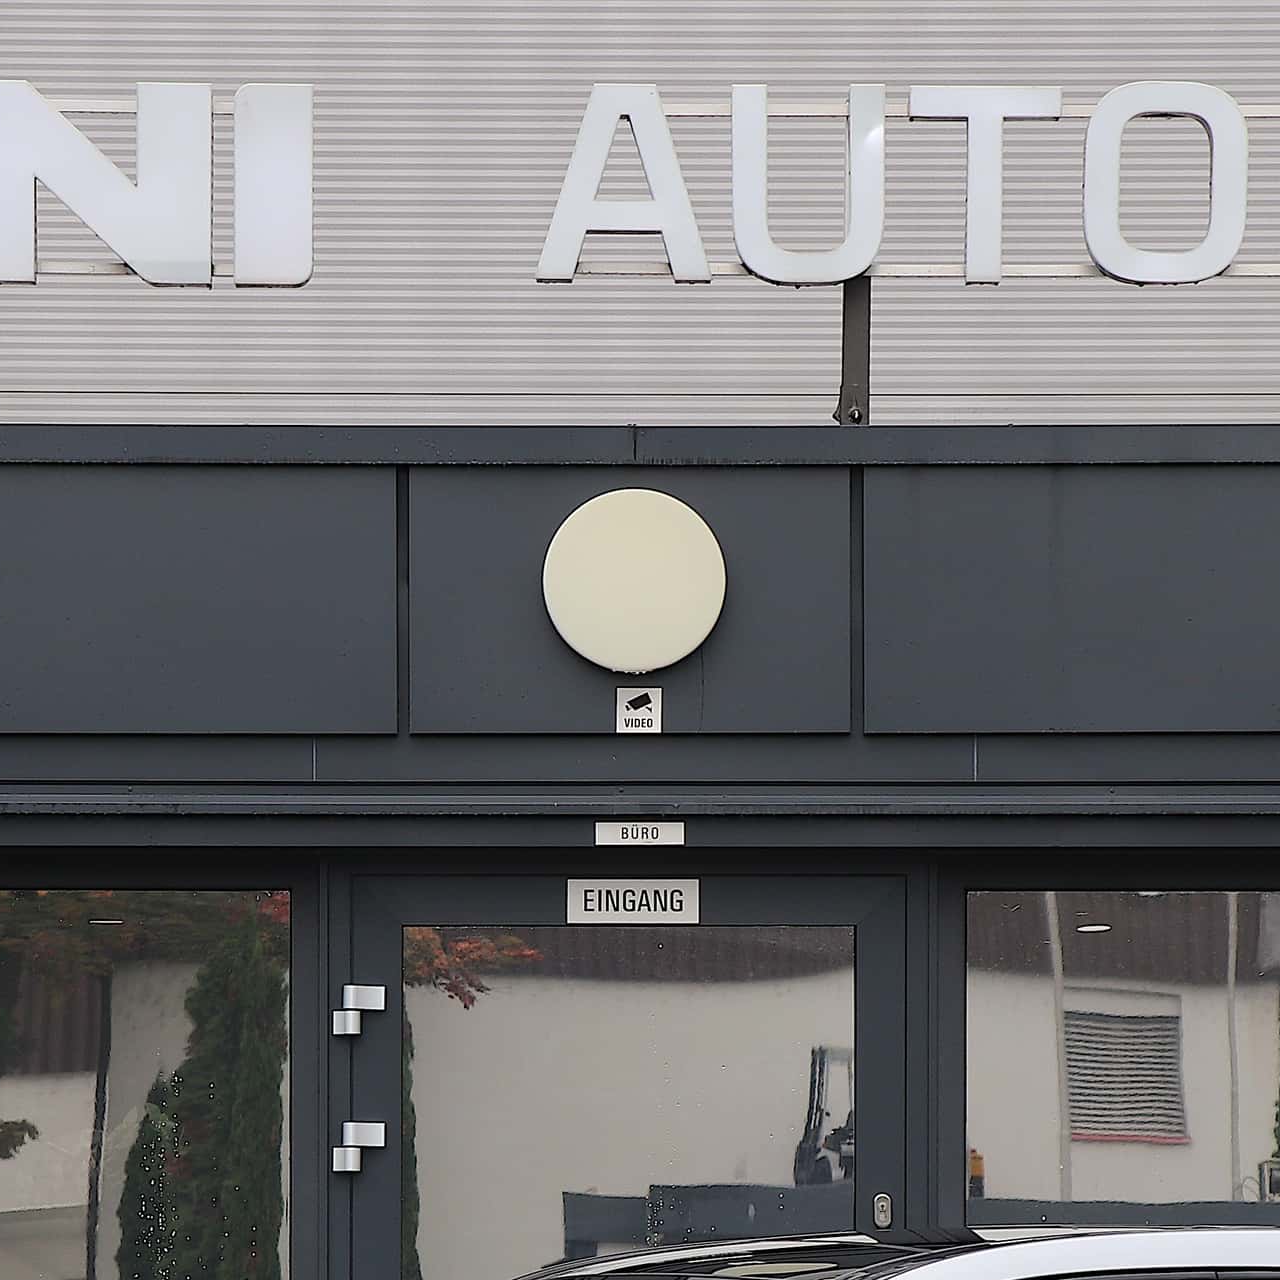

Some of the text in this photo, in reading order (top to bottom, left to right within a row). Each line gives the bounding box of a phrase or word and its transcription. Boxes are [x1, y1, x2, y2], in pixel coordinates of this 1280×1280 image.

[535, 79, 1248, 287] AUTO
[624, 718, 653, 728] VIDEO
[621, 824, 660, 840] BÜRO
[583, 889, 684, 912] EINGANG
